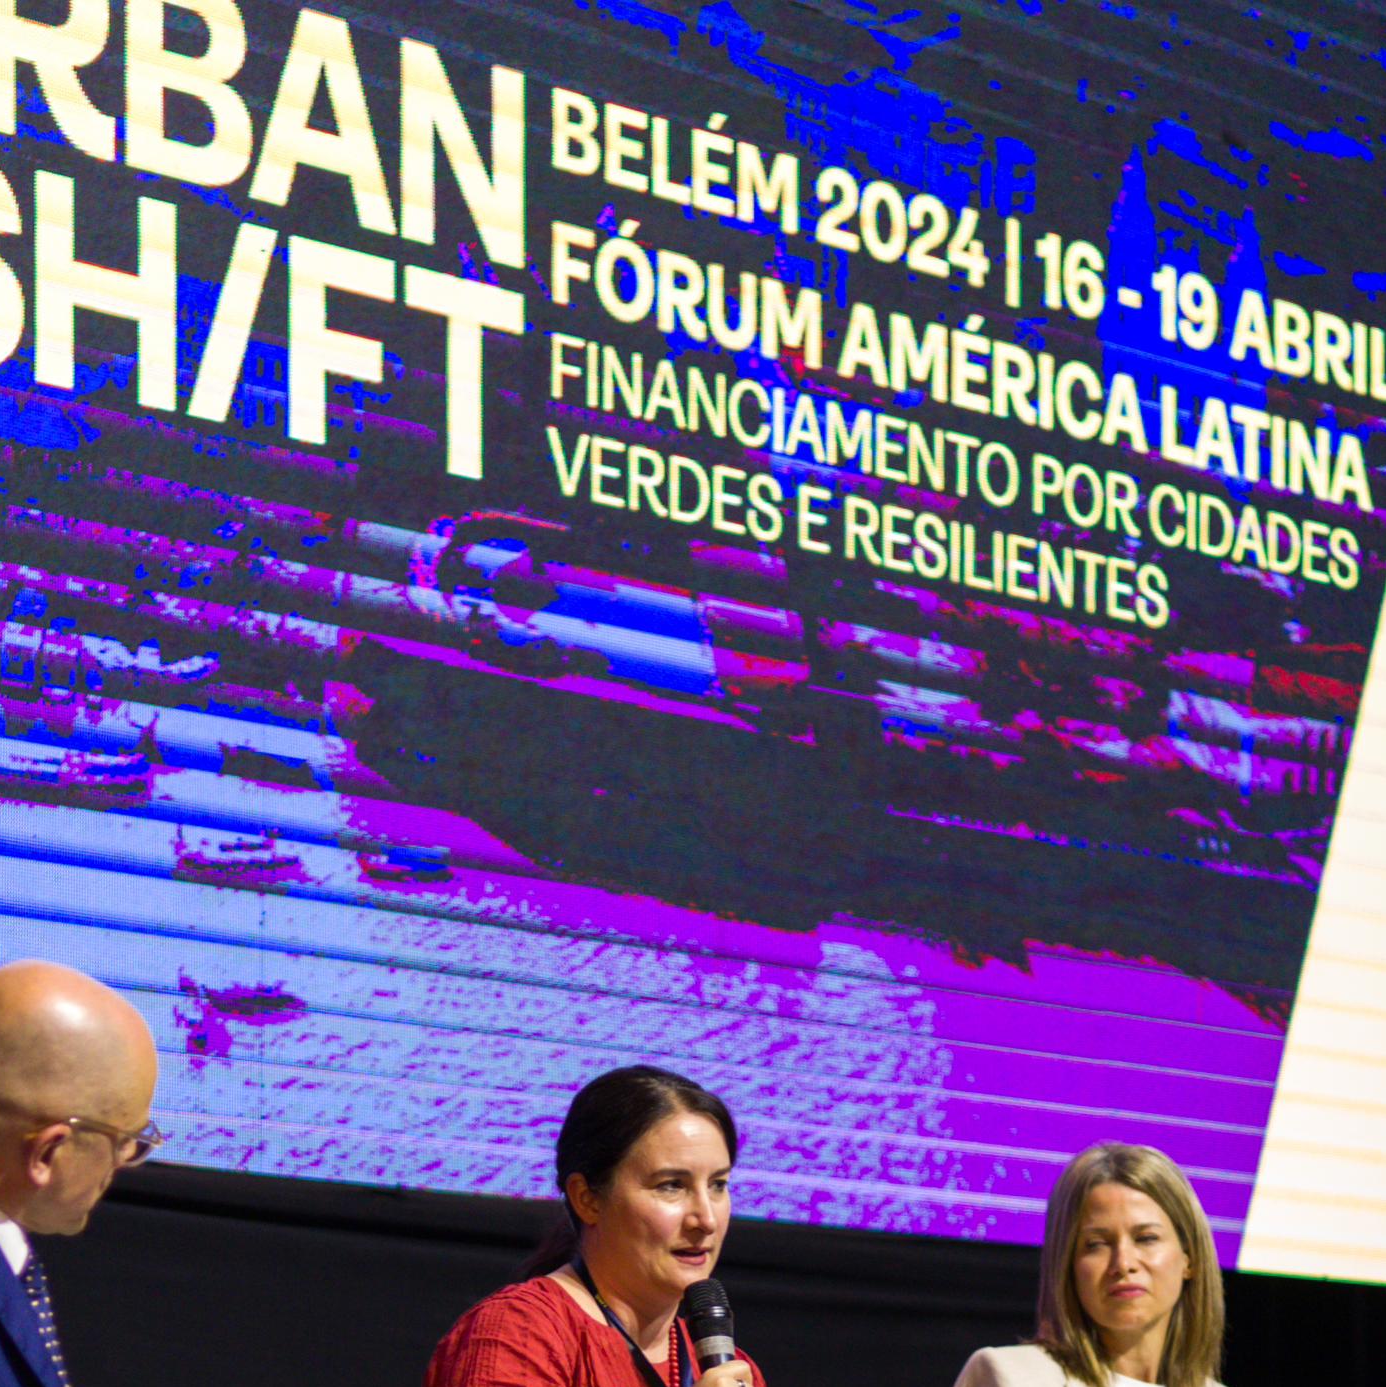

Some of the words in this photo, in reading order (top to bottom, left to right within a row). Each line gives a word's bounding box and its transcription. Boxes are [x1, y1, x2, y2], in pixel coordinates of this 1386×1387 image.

[550, 87, 801, 236] BELÉM
[815, 166, 991, 289] 2024
[1035, 232, 1106, 320] 16
[1151, 265, 1219, 350] 19
[550, 219, 824, 371] FÓRUM
[837, 302, 1149, 455] AMÉRICA
[1160, 385, 1374, 512] LATINA
[550, 332, 1021, 508] FINANCIAMENTO
[1031, 453, 1141, 538] POR
[1148, 483, 1359, 590] CIDADES
[546, 426, 784, 542] VERDES
[797, 483, 832, 554] E
[844, 494, 1170, 629] RESILIENTES
